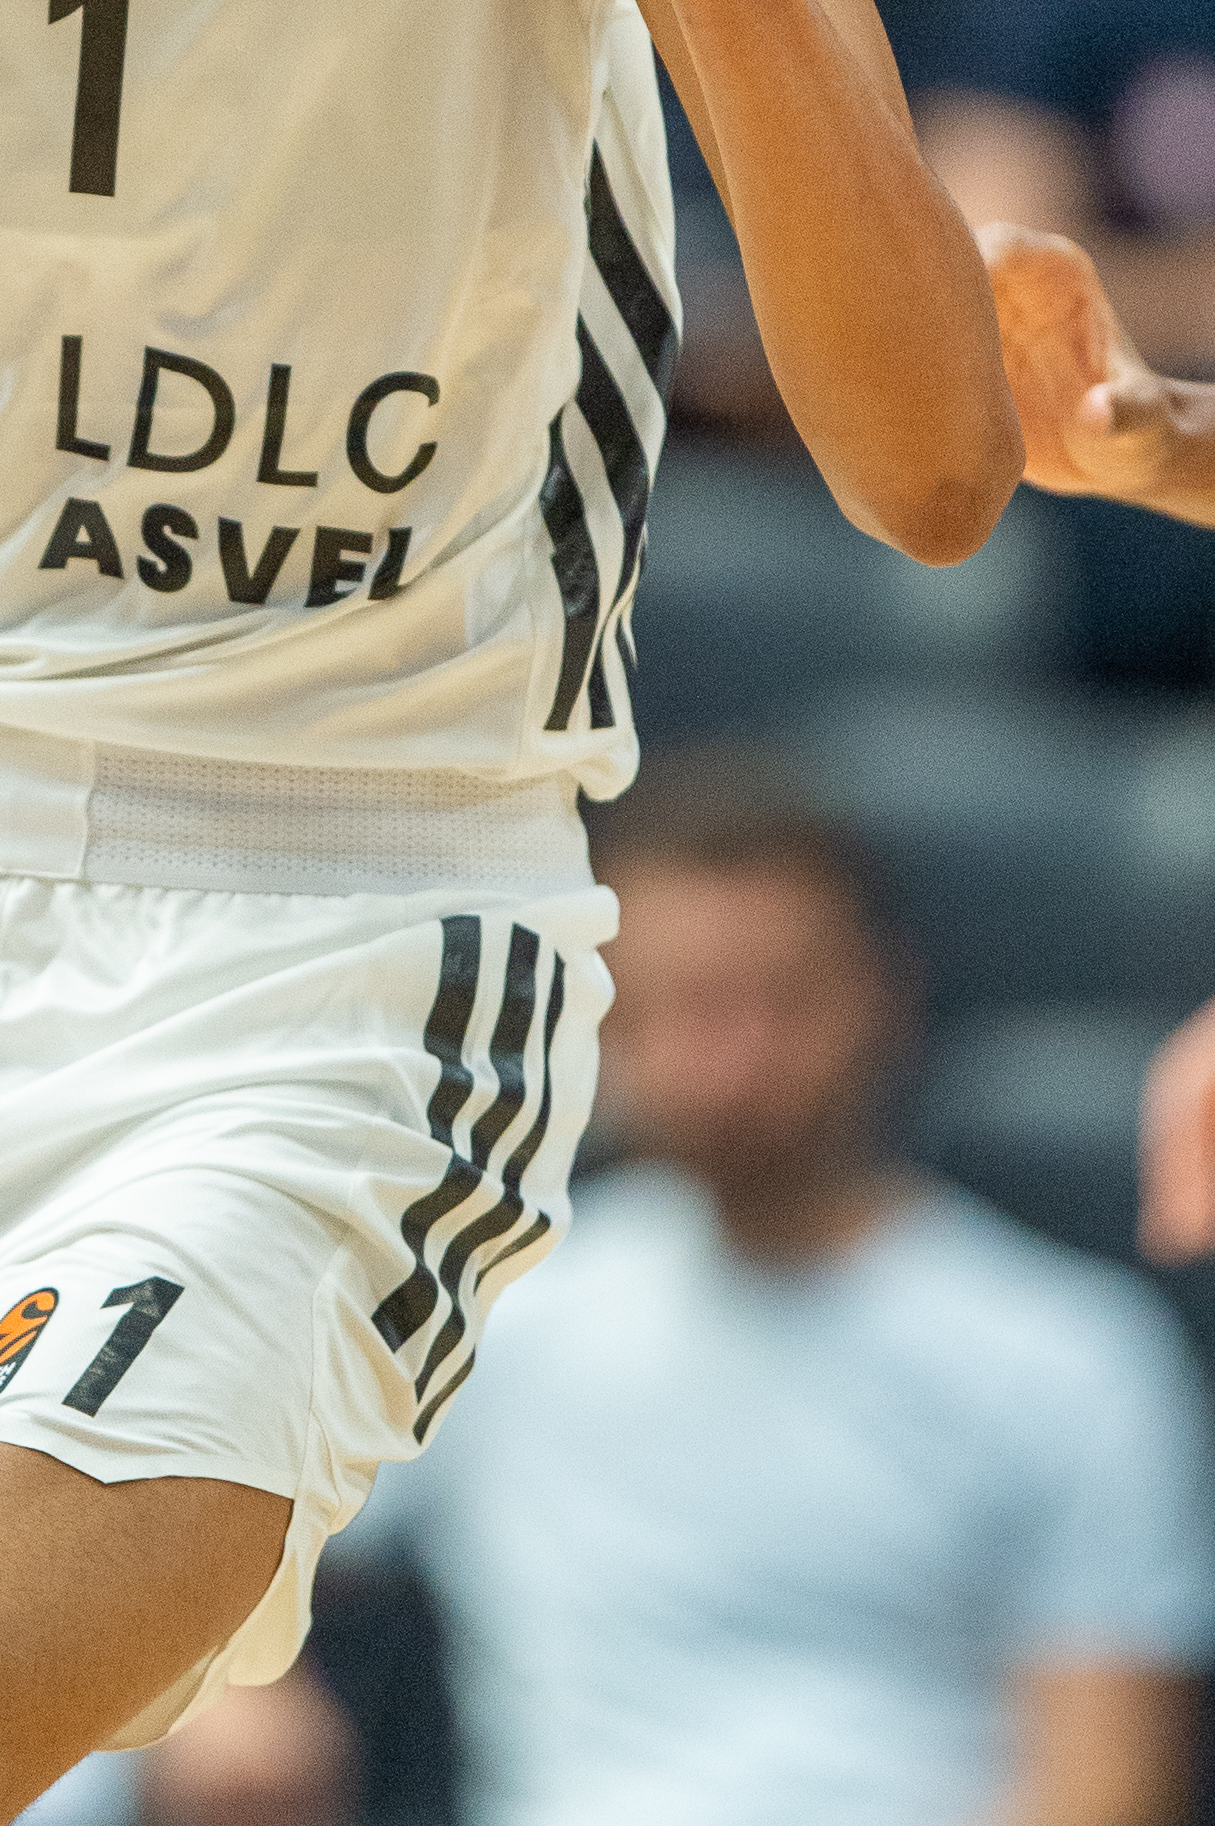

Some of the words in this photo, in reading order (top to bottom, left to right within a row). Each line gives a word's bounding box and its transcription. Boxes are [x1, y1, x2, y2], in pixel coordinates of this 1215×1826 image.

[55, 335, 440, 494] LDLC
[38, 497, 412, 608] ASVEL
[61, 1275, 185, 1418] 1
